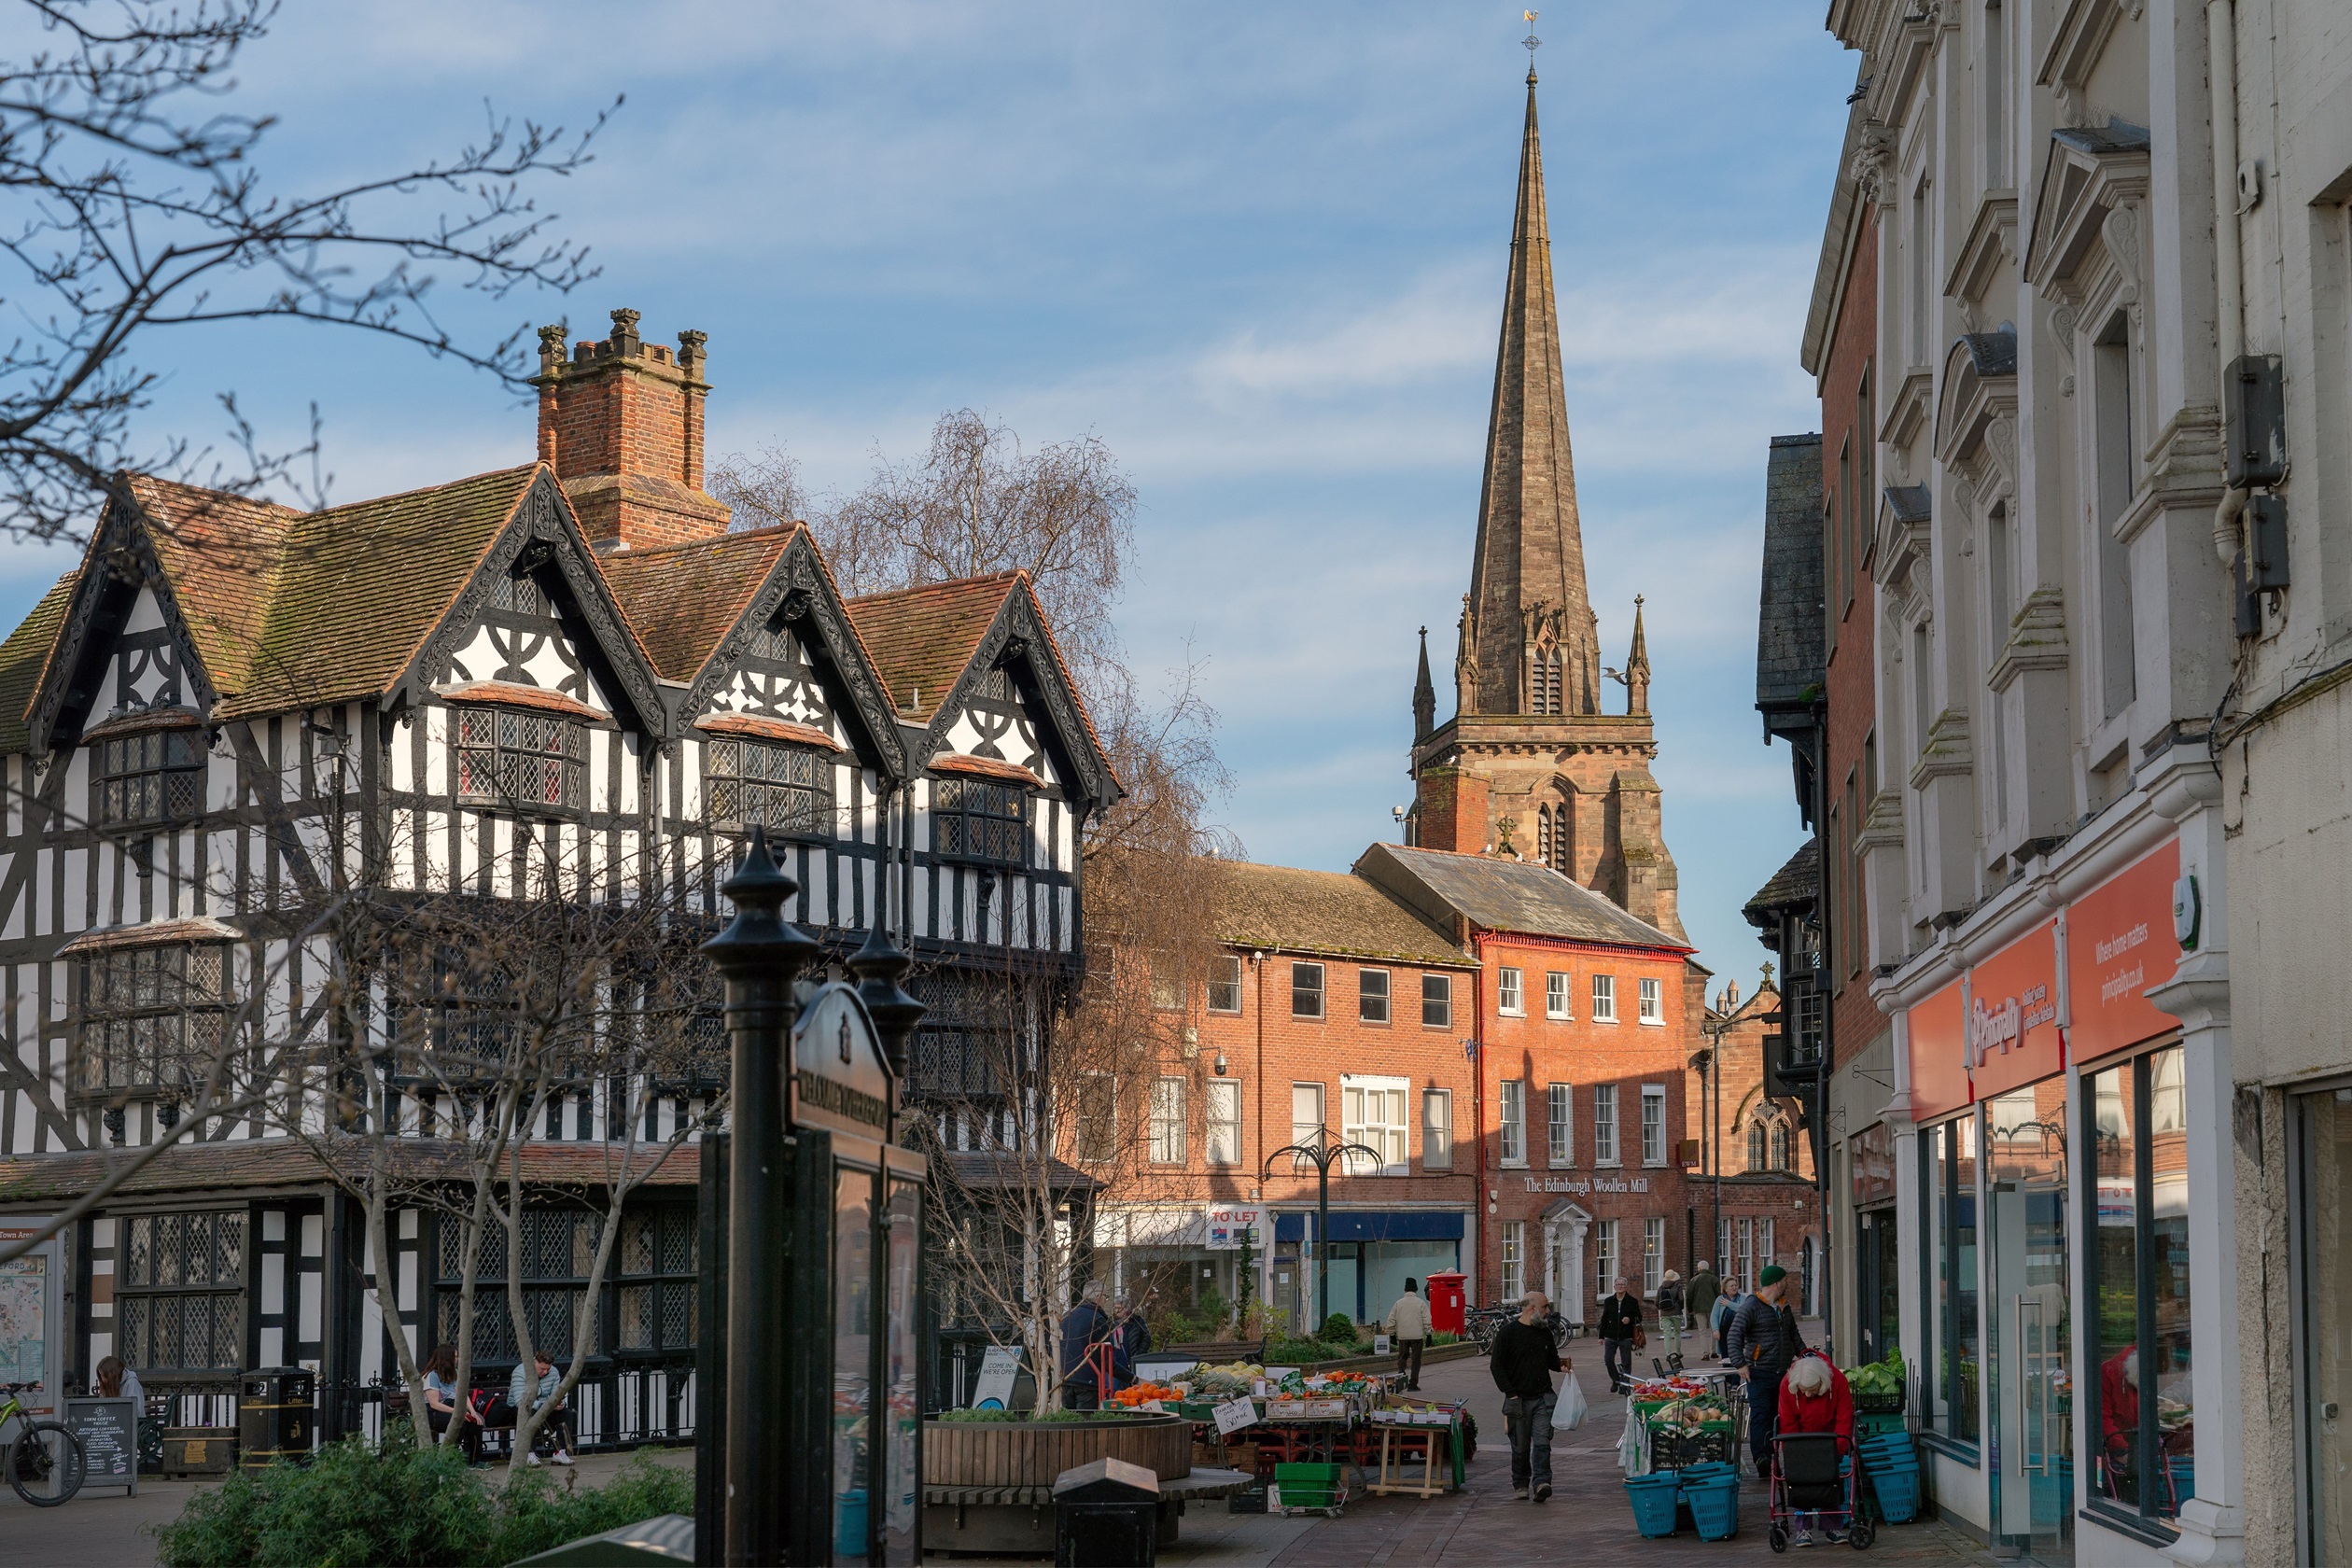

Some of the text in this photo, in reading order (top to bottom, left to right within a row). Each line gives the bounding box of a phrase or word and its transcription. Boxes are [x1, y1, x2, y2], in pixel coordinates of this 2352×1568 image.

[2095, 922, 2148, 965] Where home matters
[2102, 959, 2144, 1008] principality.co.uk
[1981, 997, 2023, 1055] Principality
[1524, 1177, 1647, 1197] The Edinburgh Woollen Mill
[1211, 1211, 1258, 1222] TO LET
